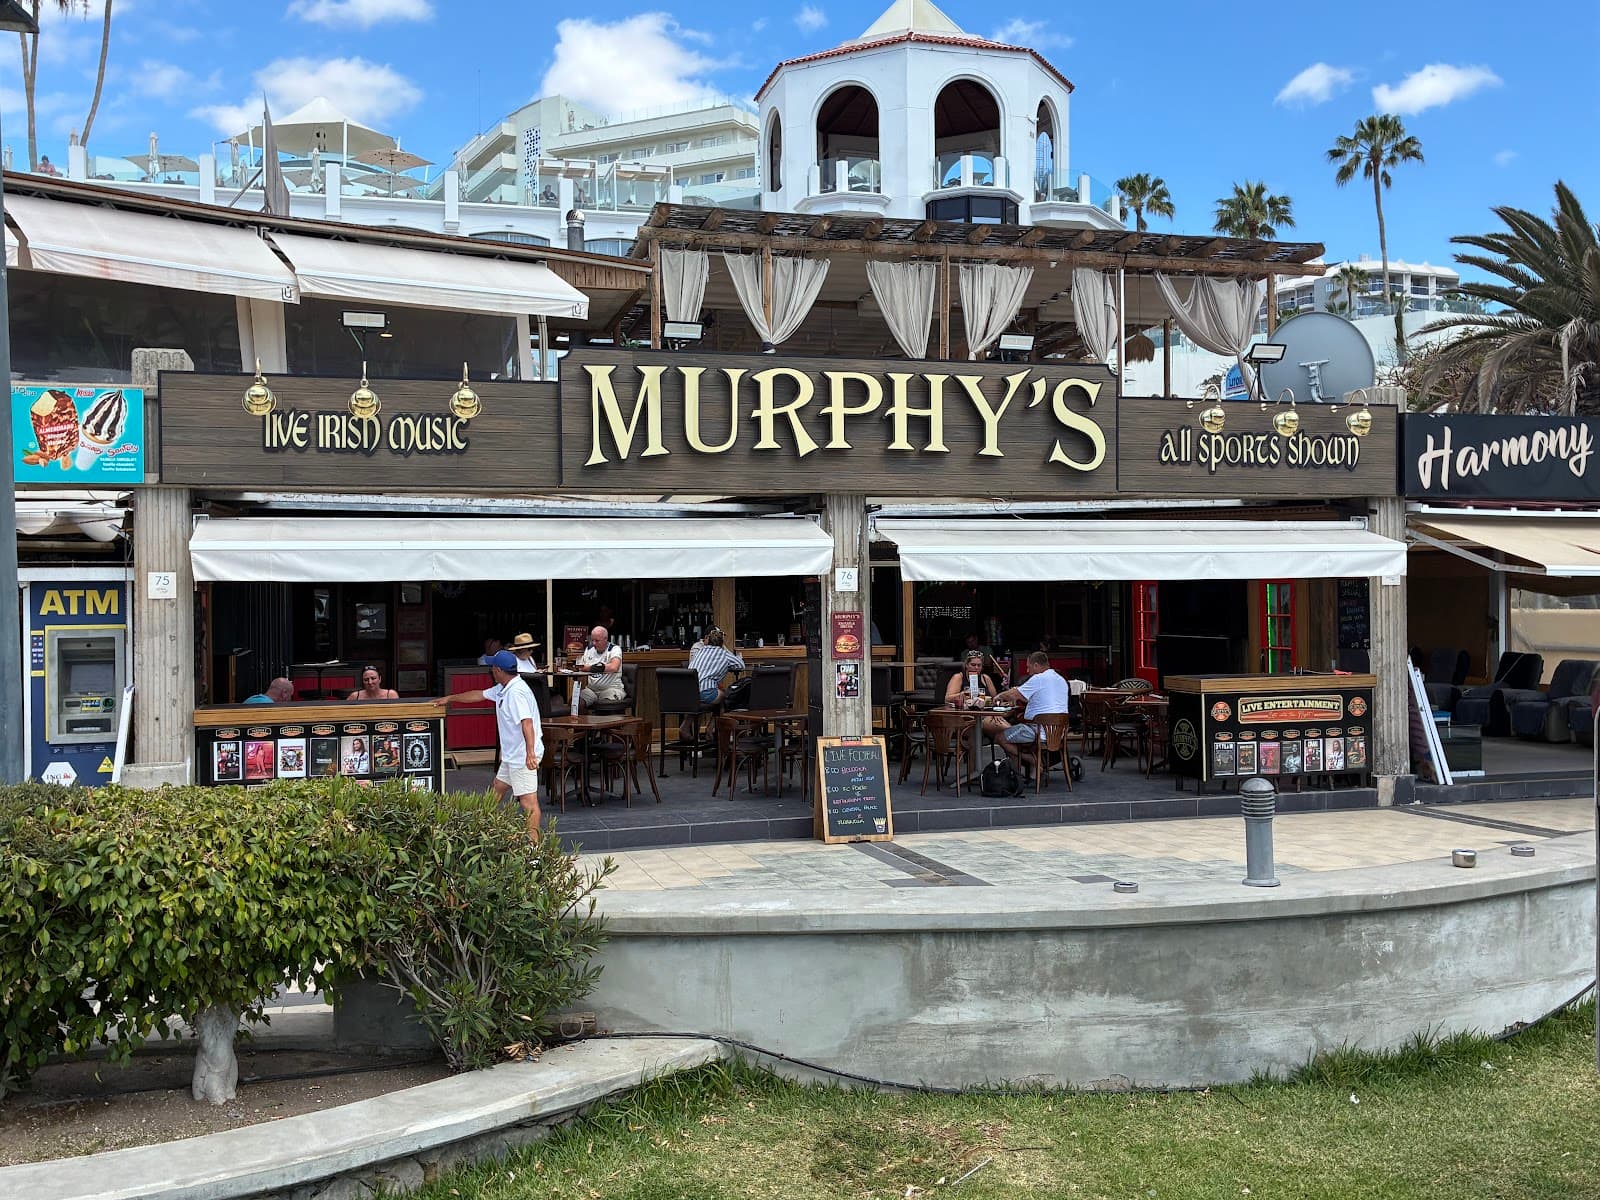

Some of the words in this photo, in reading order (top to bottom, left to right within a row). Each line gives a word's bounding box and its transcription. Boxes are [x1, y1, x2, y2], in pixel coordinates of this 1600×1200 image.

[583, 365, 1107, 472] MURPHY'S
[1418, 422, 1594, 491] Harmony
[155, 575, 170, 586] 75
[841, 571, 853, 581] 76
[39, 589, 119, 616] ATM
[1242, 702, 1263, 713] LIVE
[1263, 699, 1340, 710] ENTERTAINMENT
